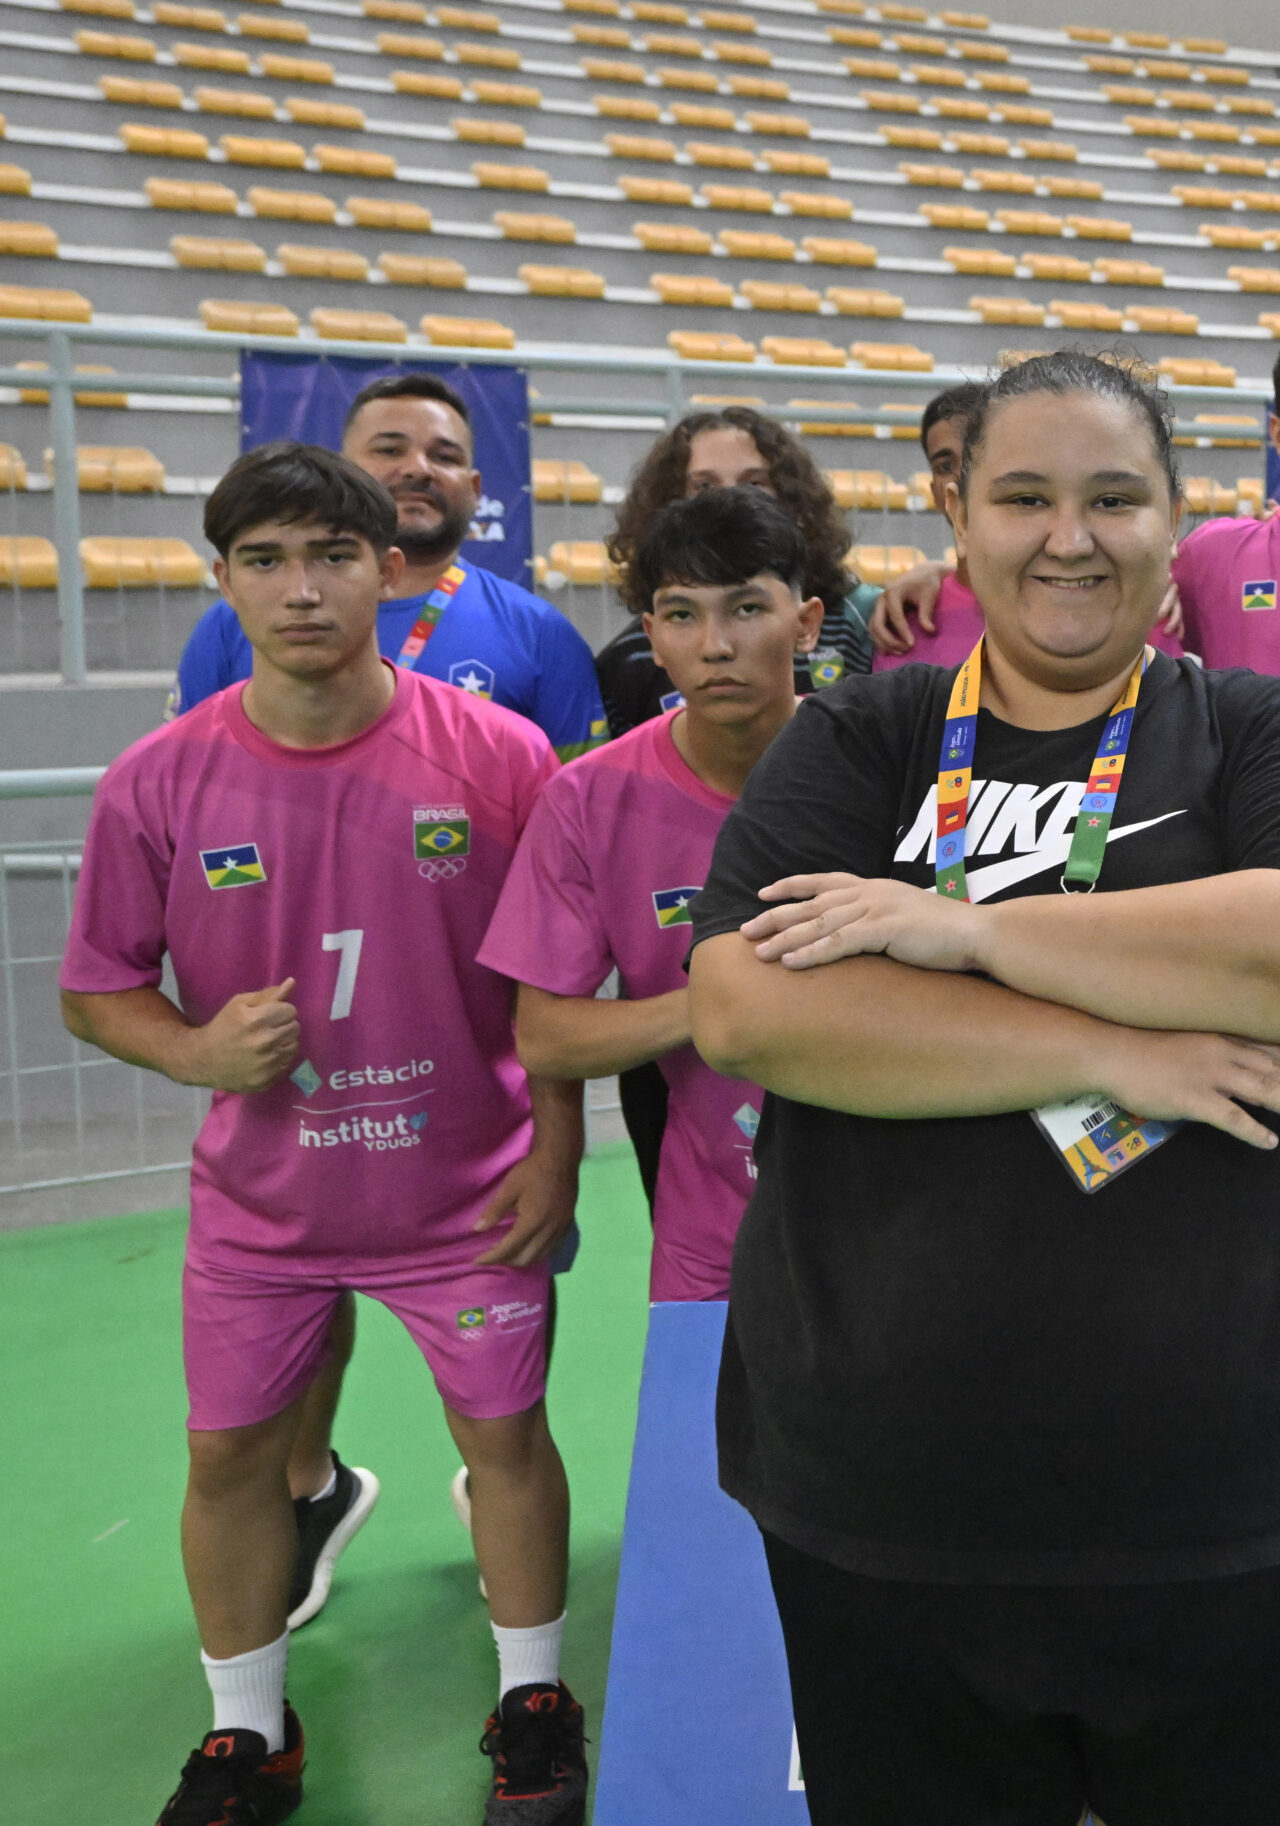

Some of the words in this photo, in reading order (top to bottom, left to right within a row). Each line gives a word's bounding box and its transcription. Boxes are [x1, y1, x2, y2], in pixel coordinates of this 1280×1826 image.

[413, 808, 469, 821] BRASIL
[893, 780, 1089, 865] NIKE
[322, 929, 363, 1021] 7
[329, 1059, 434, 1091] Estácio
[363, 1133, 421, 1152] YDUQS
